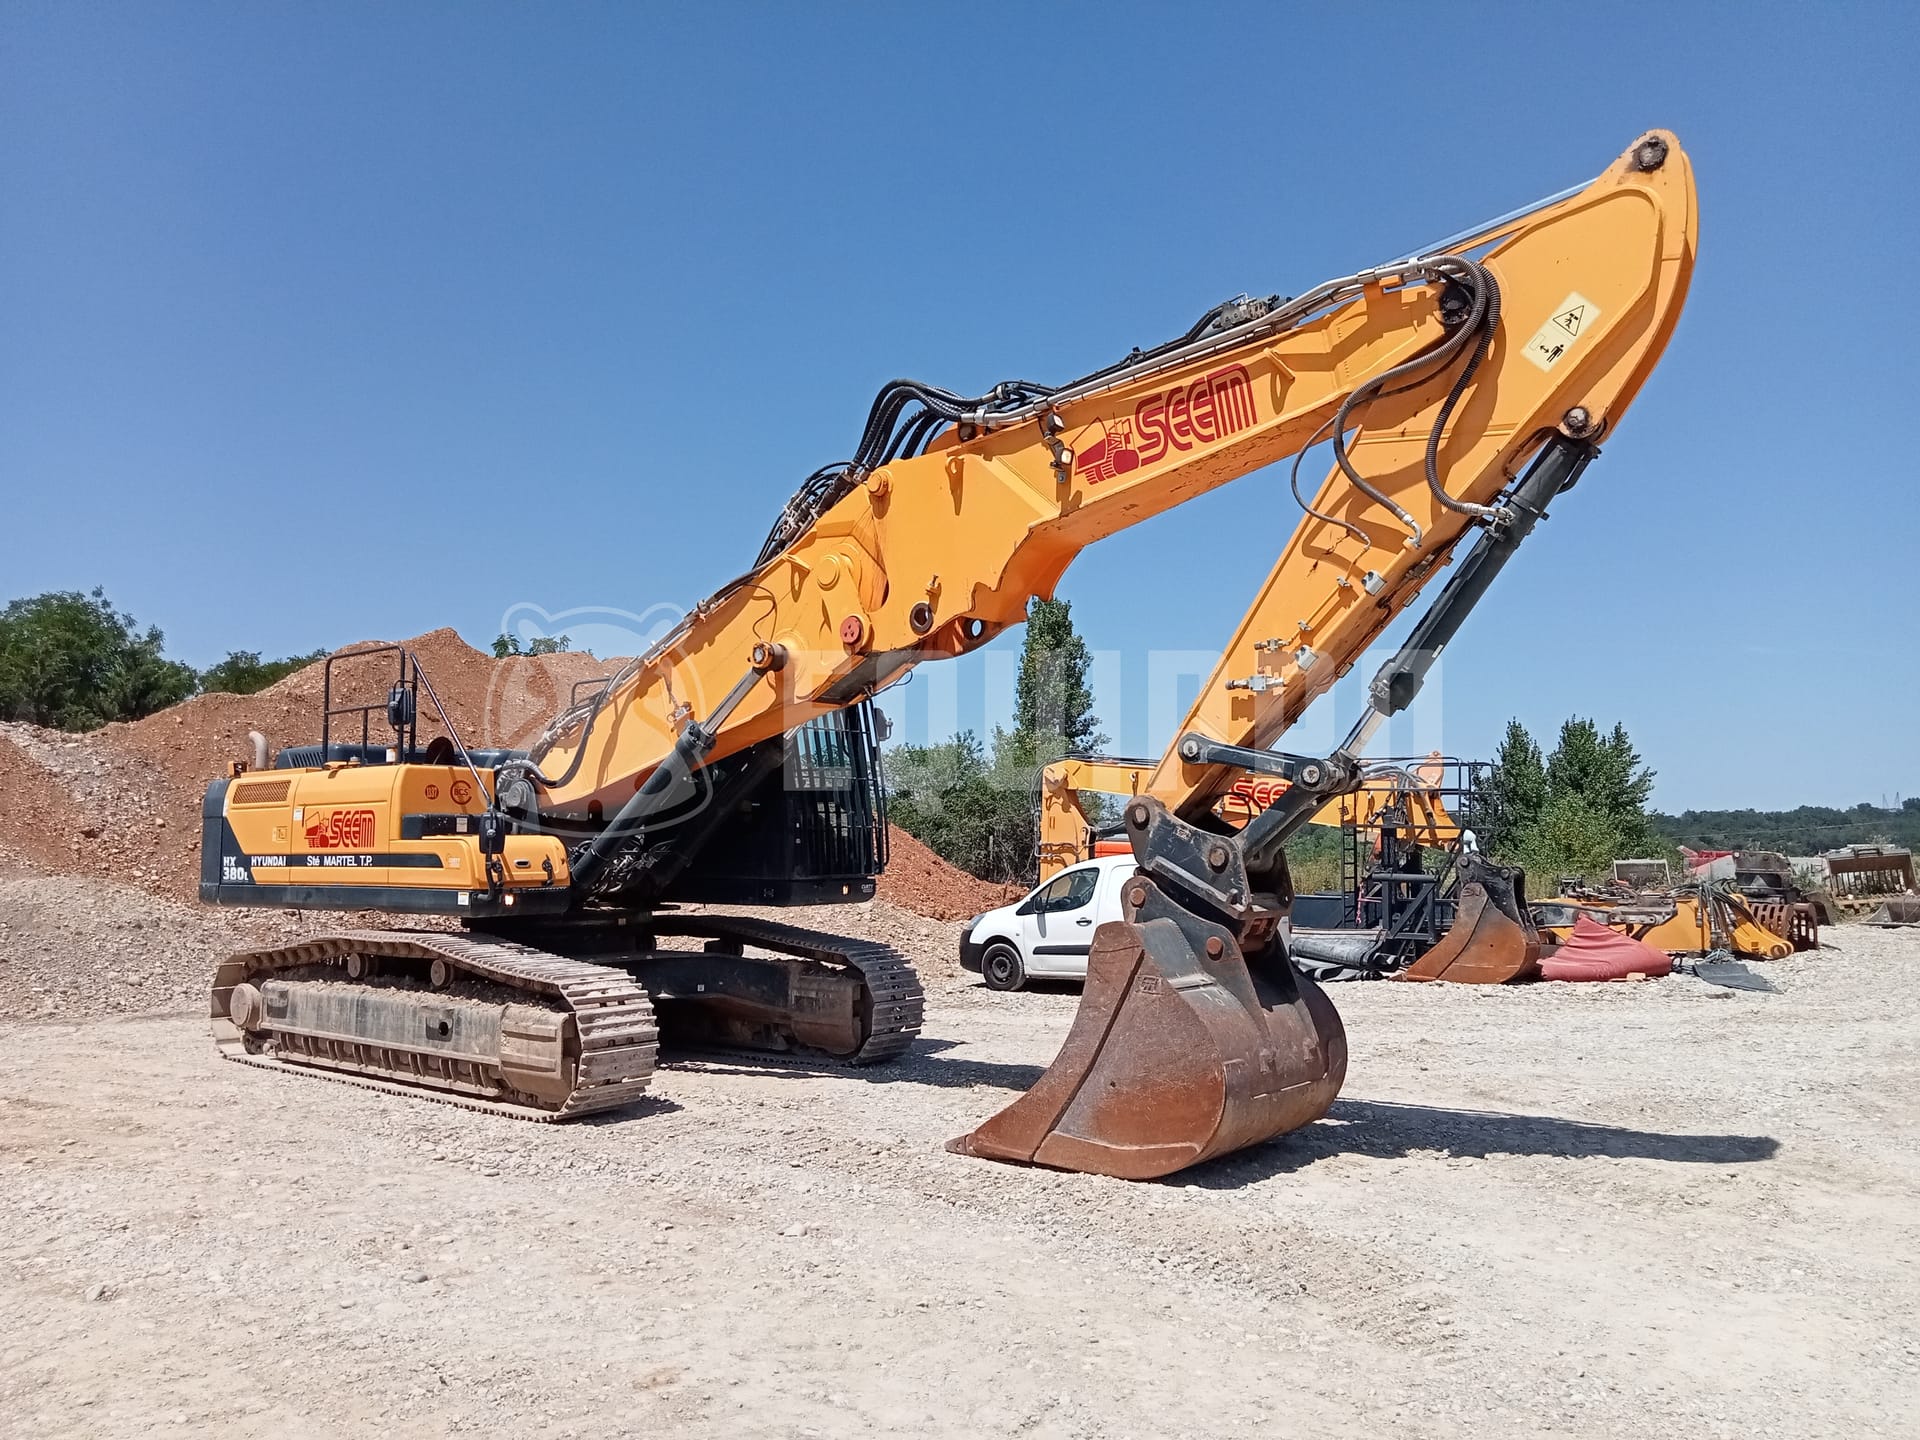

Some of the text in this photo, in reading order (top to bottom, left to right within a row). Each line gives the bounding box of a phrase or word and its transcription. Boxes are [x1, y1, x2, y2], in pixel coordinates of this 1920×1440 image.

[1228, 778, 1294, 812] SEE
[223, 856, 237, 867] HX
[251, 856, 287, 867] HYUNDAI
[323, 855, 358, 867] MARTEL
